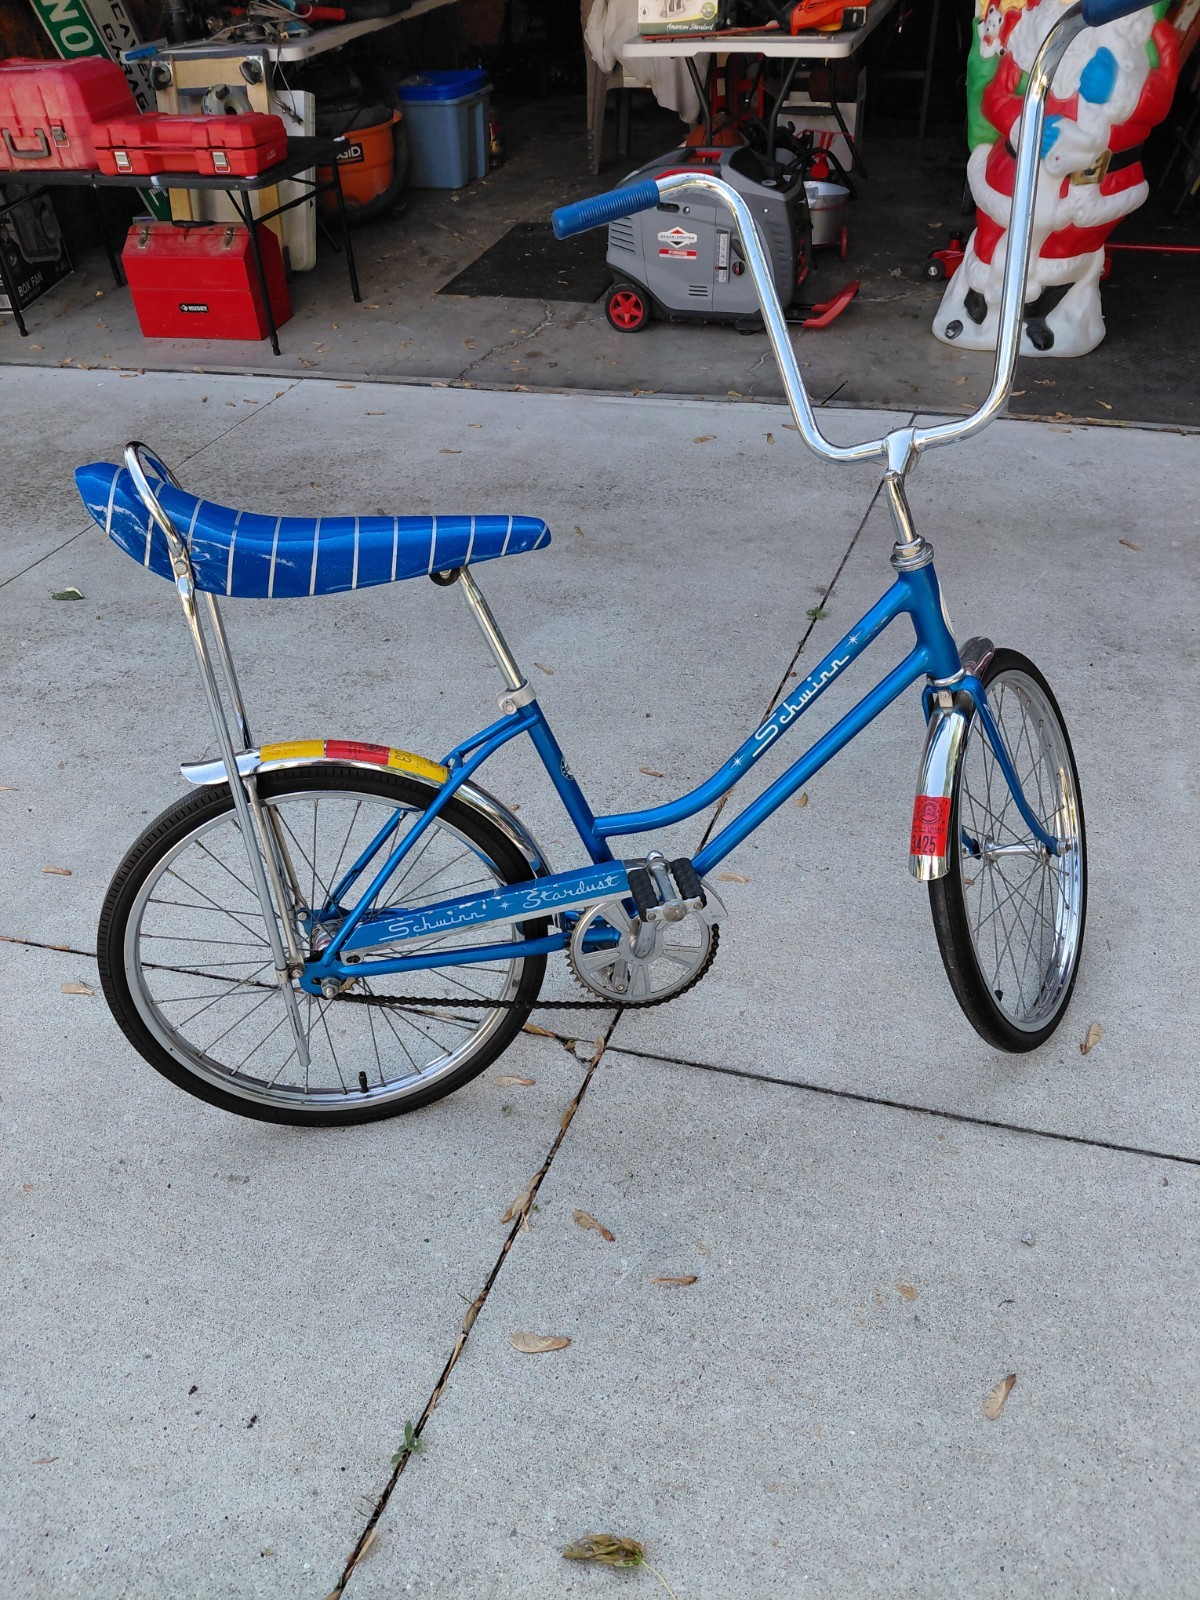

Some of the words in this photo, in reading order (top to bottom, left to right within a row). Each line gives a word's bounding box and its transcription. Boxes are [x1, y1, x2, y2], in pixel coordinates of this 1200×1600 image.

[102, 23, 149, 111] GARAG
[17, 280, 31, 297] BOX
[30, 271, 43, 288] FAN
[752, 655, 850, 758] Schwinn
[379, 910, 486, 941] Schwinn
[522, 874, 625, 909] Stardust
